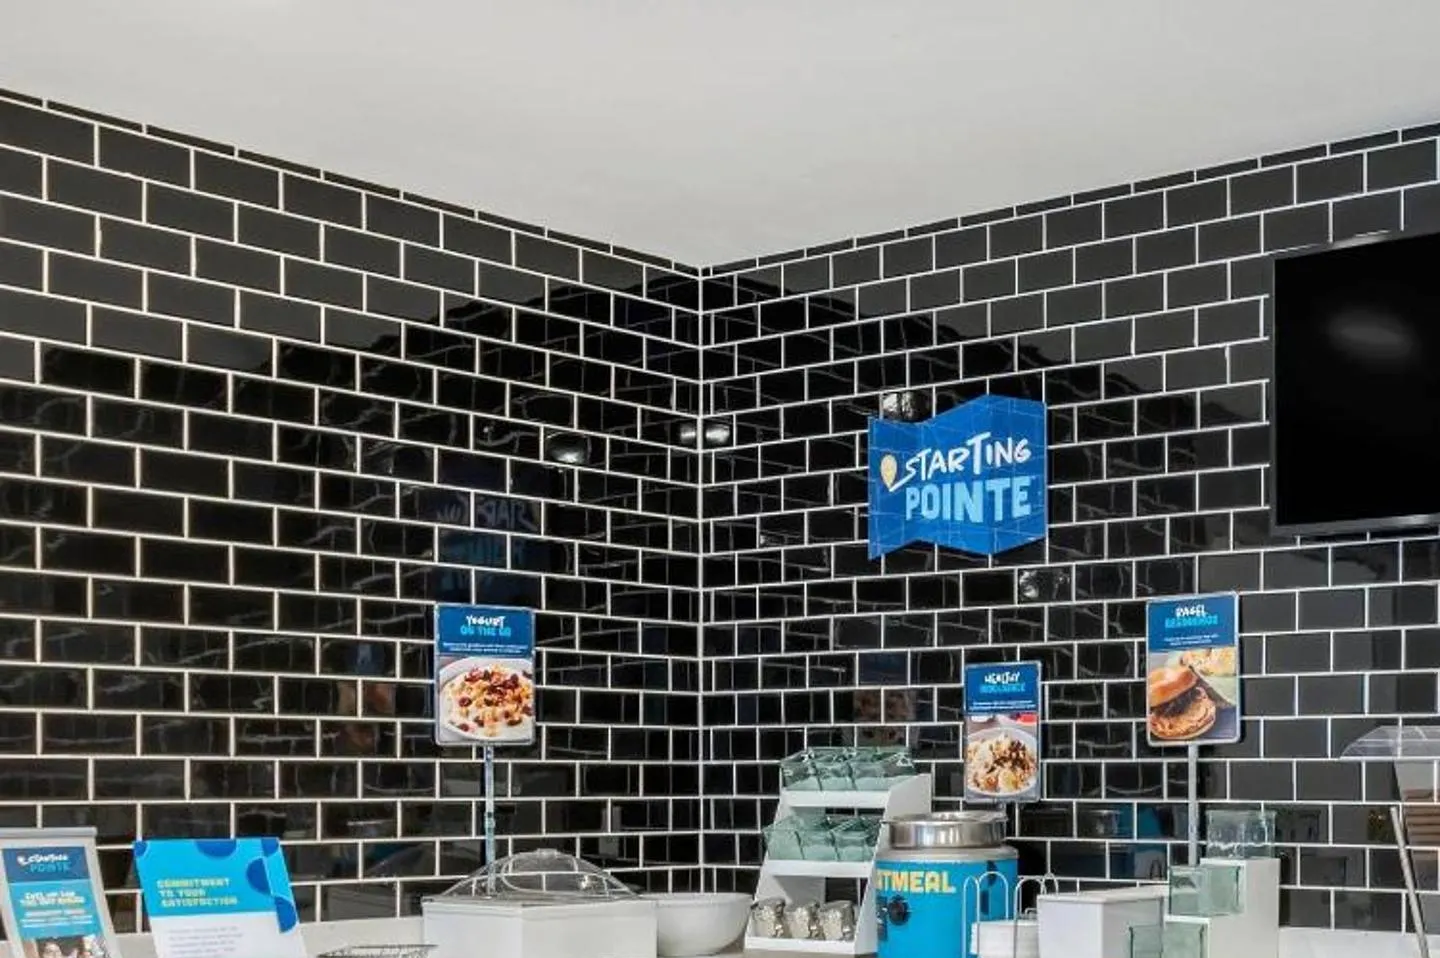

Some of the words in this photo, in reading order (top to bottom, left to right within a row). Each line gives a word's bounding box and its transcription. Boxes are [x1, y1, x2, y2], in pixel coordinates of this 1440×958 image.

[905, 476, 1032, 524] POINTE
[465, 614, 506, 629] YOGURT
[874, 869, 957, 893] TMEAL
